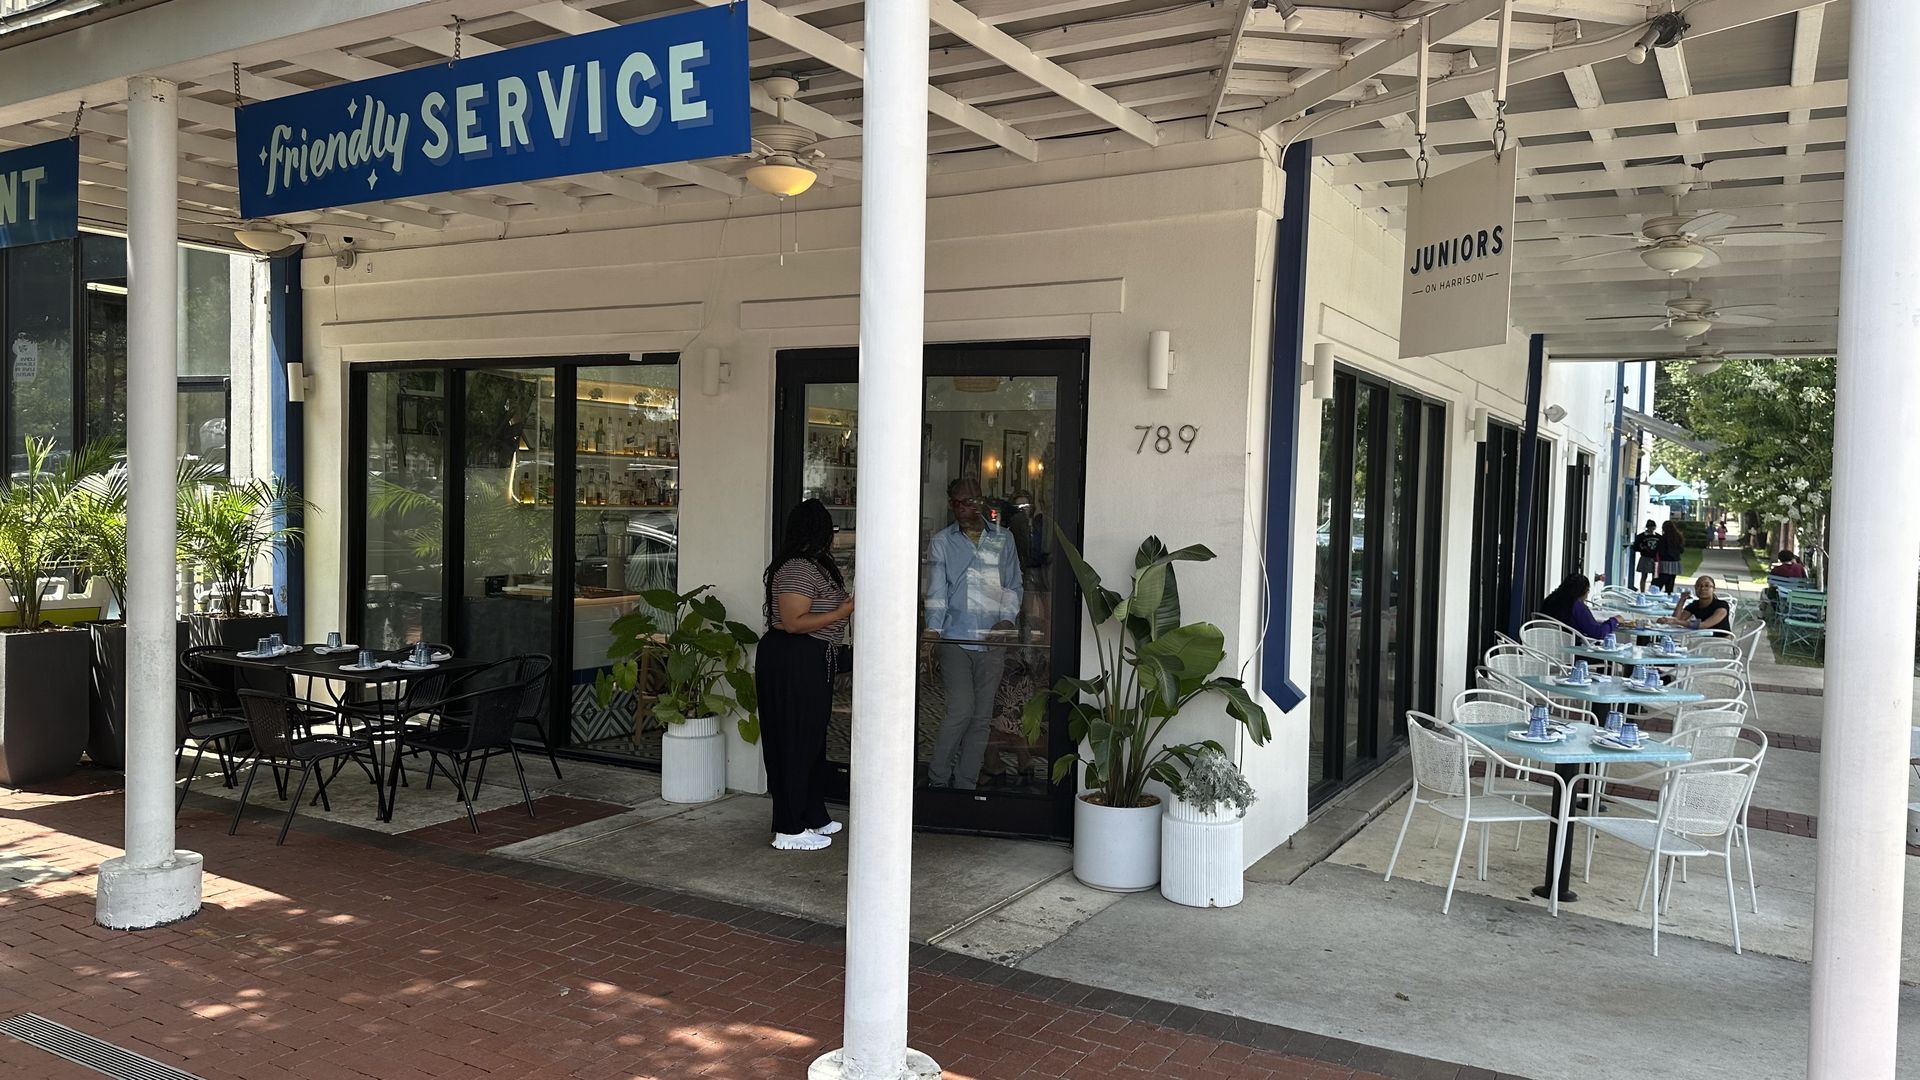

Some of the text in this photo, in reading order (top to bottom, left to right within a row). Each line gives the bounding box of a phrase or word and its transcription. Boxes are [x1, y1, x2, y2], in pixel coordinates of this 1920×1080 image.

[266, 40, 710, 196] friendly SERVICE
[1410, 225, 1503, 275] JUNIORS
[1425, 272, 1484, 294] ON HARRISON
[1134, 424, 1198, 454] 789
